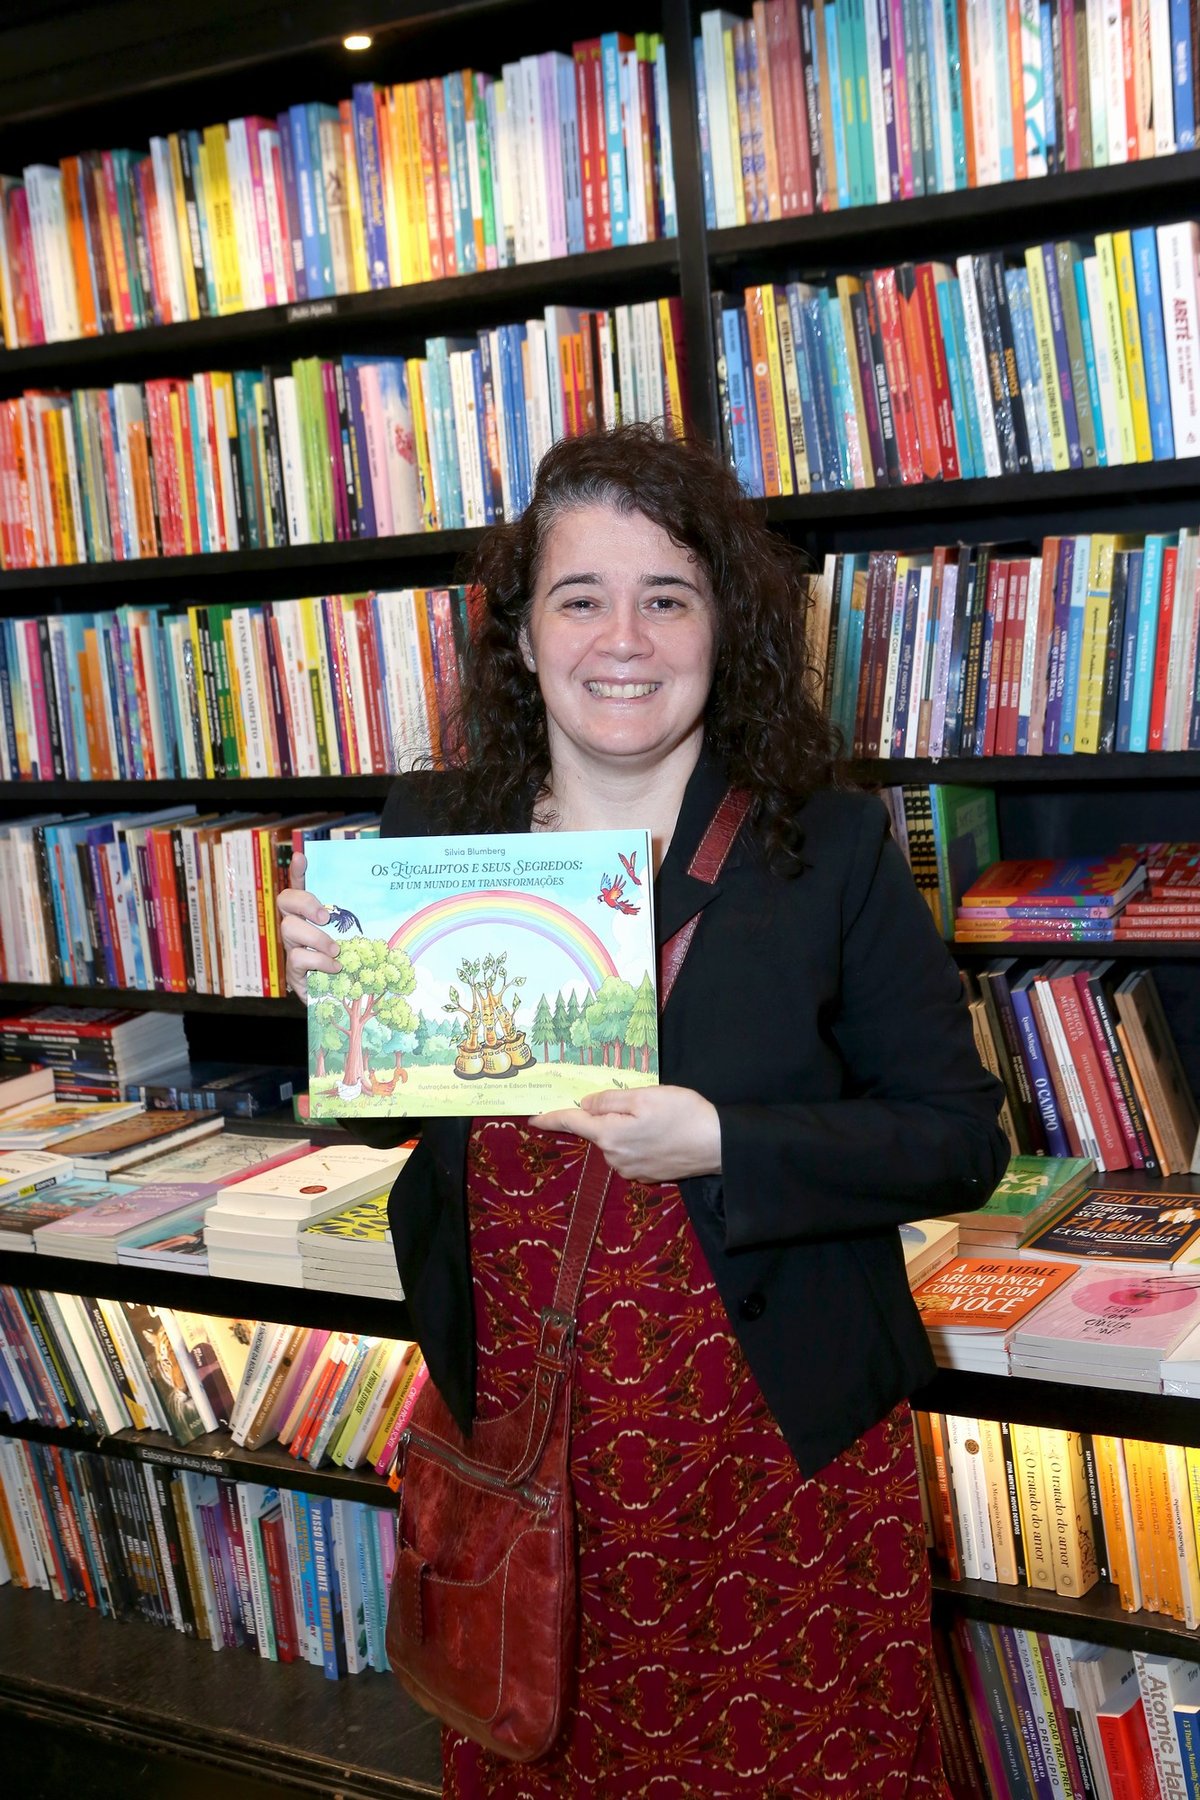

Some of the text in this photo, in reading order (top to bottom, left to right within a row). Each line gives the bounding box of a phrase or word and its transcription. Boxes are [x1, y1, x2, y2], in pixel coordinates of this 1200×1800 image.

[1004, 348, 1019, 397] SONHOS
[1072, 359, 1090, 418] SINAIS
[876, 364, 893, 439] COMO NÃO TER MEDO
[761, 409, 771, 424] SER
[763, 428, 773, 448] VOCÊ
[1143, 544, 1156, 606] FELIPE LIMA
[893, 609, 901, 636] PENSAR
[891, 638, 899, 654] COM
[902, 645, 912, 664] água
[238, 626, 251, 685] ENEAGRAMA
[246, 688, 258, 739] COMPLETO
[899, 671, 909, 694] como
[898, 696, 908, 712] Seja
[445, 848, 505, 856] Silvia Blumberg
[472, 864, 479, 872] E
[482, 863, 511, 872] SEUS
[513, 860, 583, 875] SEGREDOS:
[390, 875, 564, 890] EM UM MUNDO EM TRANSFORMAÇÕES
[1060, 995, 1078, 1042] MEIRELLES
[1069, 998, 1084, 1036] PATRICIA
[1096, 996, 1106, 1020] CHARLES
[1035, 1078, 1058, 1131] O CAMPO
[1081, 1054, 1114, 1149] INTELIGÊNCIA DO CORAÇÃO
[1075, 1211, 1142, 1222] SER UMA
[1082, 1205, 1127, 1213] COMO
[1062, 1218, 1192, 1236] FAMÍLIA
[935, 1274, 1046, 1287] ABUNDÂNCIA
[952, 1264, 967, 1273] A
[973, 1264, 1061, 1276] JOE VITALE
[922, 1284, 1038, 1297] COMEÇA COM
[949, 1297, 1025, 1313] VOCÊ
[93, 1309, 108, 1337] SUCESSO
[103, 1338, 115, 1354] NÃO
[113, 1361, 125, 1380] SORTE
[387, 1386, 417, 1449] CRIE SUA PRÓPRIA SORTE
[142, 1449, 223, 1472] Estoque de Auto Ajuda
[992, 1487, 1000, 1519] Mensageira
[1025, 1458, 1044, 1562] O tratado do amor
[1051, 1463, 1069, 1568] O tratado do amor
[1012, 1513, 1020, 1534] DESAFIOS
[311, 1509, 328, 1592] PASSO DO GIGANTE
[234, 1545, 250, 1591] MANIFESTAÇÃO
[242, 1602, 255, 1634] PROPÓSITO
[320, 1596, 333, 1651] KLEBER REIS
[1003, 1635, 1012, 1658] Nicole
[994, 1695, 1003, 1713] PODER
[1147, 1675, 1176, 1753] Atomic
[1183, 1720, 1189, 1728] 15
[1024, 1710, 1034, 1732] COMO
[1033, 1743, 1044, 1771] TORNAR
[1185, 1729, 1194, 1751] Things
[1041, 1728, 1059, 1786] PRINCÍPIO
[1046, 1712, 1072, 1797] NAÇÃO TARJA PRETA
[1071, 1727, 1090, 1790] Além da Ansiedade
[1189, 1753, 1199, 1781] Mentally
